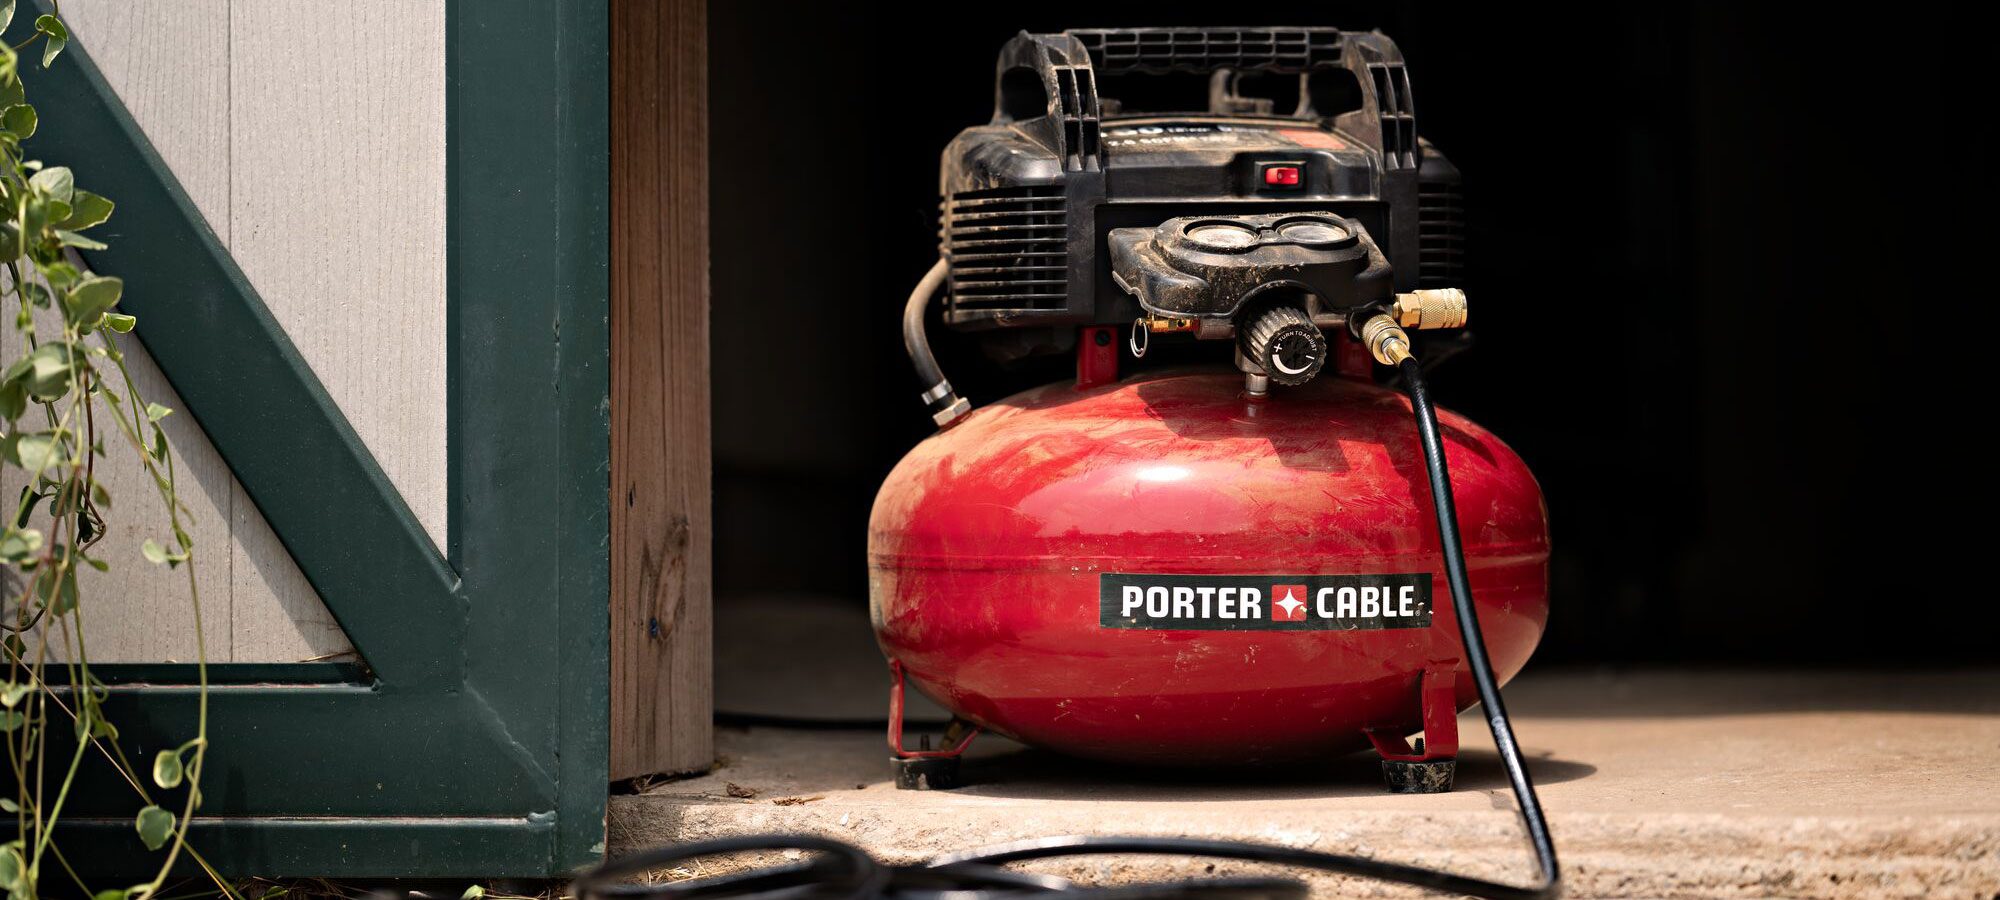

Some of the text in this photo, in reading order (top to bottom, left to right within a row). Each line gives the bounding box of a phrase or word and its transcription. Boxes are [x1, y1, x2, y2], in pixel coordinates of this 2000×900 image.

[1278, 331, 1294, 342] TURN
[1303, 332, 1317, 351] ADJUST
[1122, 585, 1415, 619] PORTER CABLE
